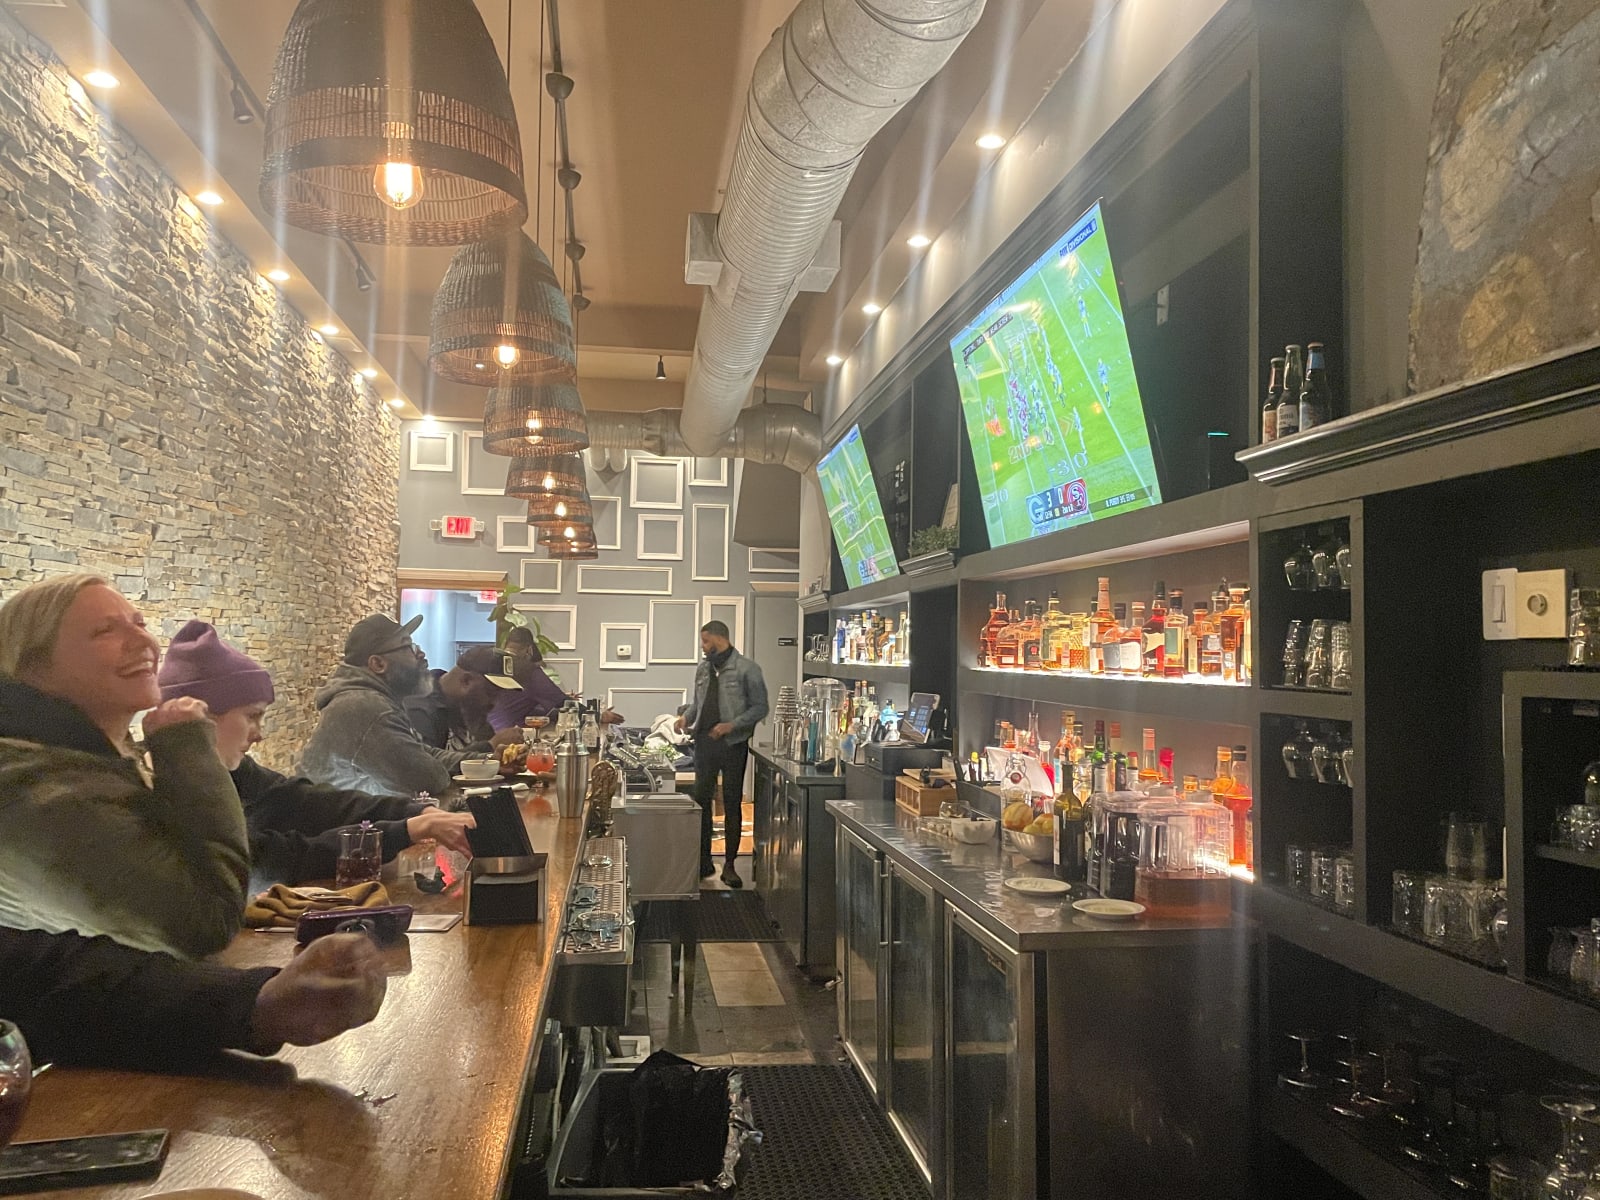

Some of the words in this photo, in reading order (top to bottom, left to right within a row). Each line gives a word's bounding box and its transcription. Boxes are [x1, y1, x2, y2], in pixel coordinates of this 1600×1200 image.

[1046, 492, 1053, 508] 3
[1057, 488, 1064, 504] 0
[448, 517, 471, 536] EXIT
